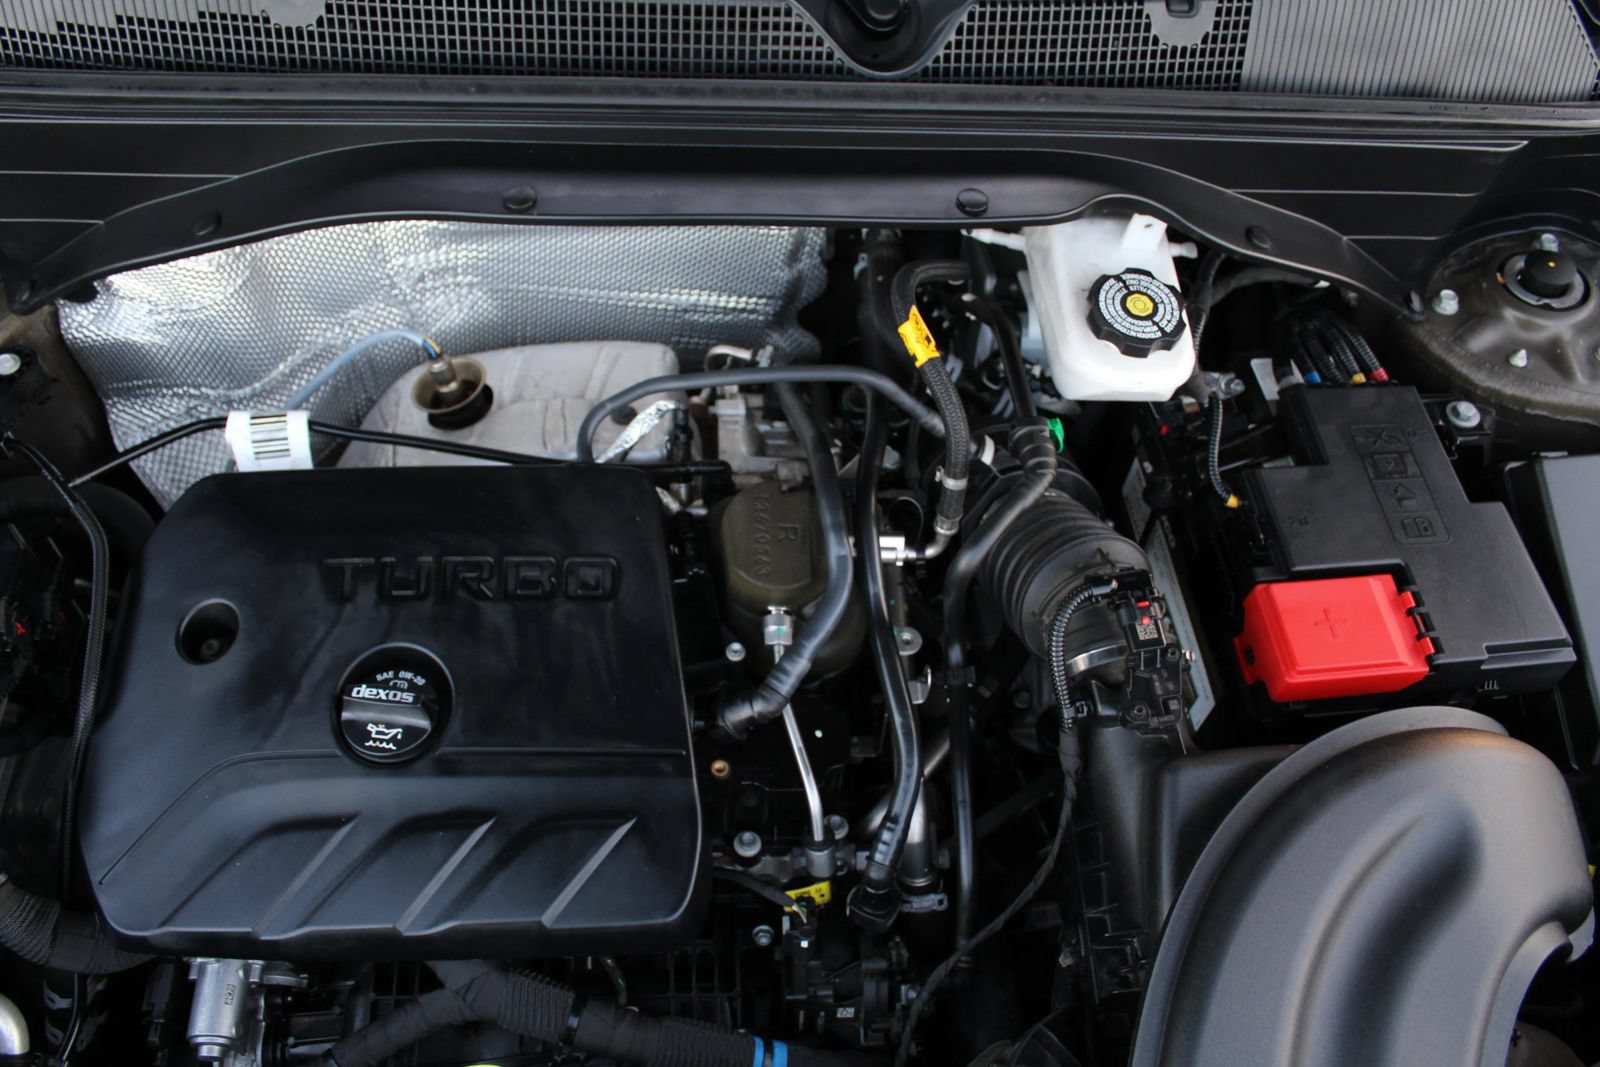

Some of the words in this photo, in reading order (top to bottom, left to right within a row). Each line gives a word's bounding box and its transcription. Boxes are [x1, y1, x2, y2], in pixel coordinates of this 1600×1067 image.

[777, 523, 800, 542] R
[322, 556, 619, 599] TURBO
[376, 670, 394, 682] SAE
[398, 670, 426, 686] 0W-20
[351, 684, 416, 703] dexos
